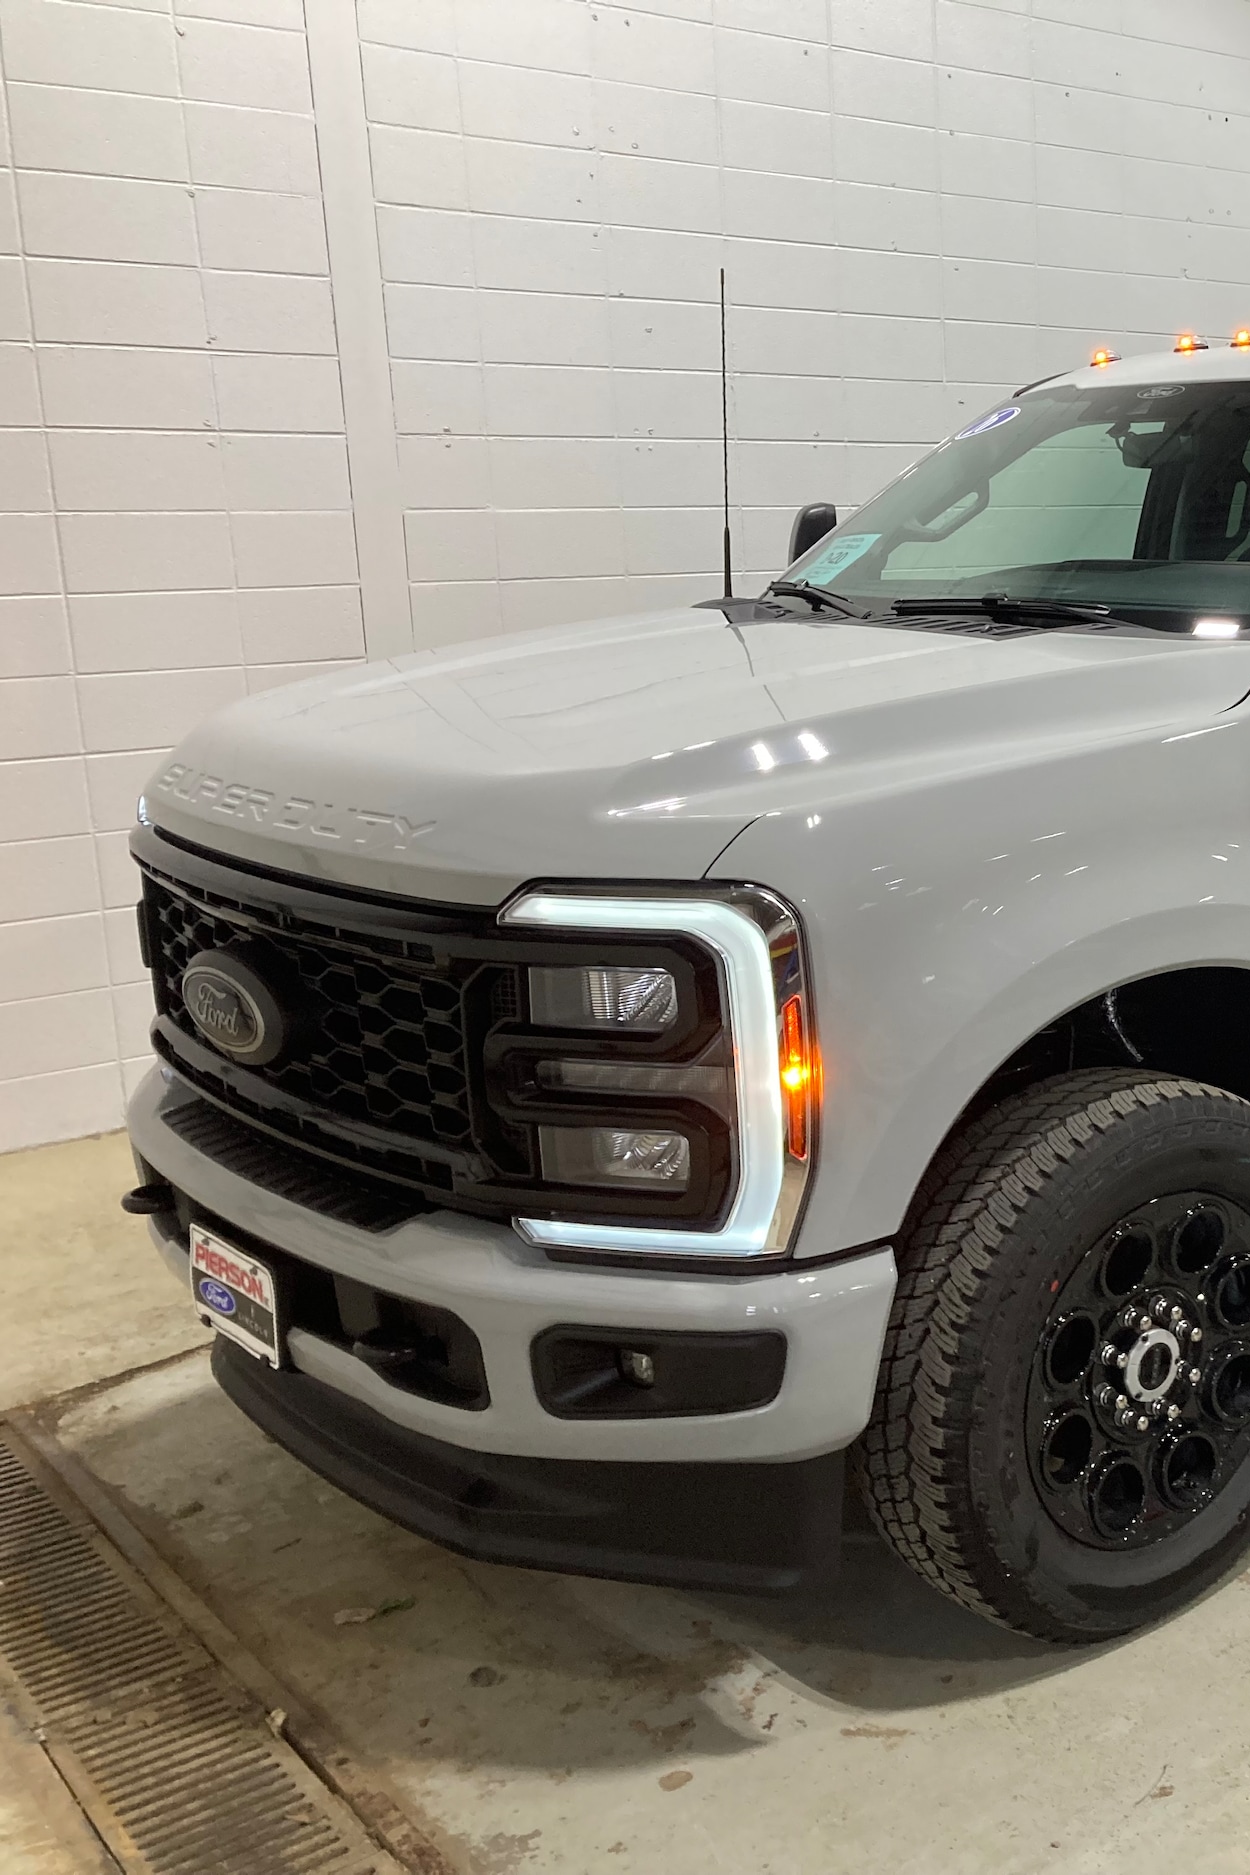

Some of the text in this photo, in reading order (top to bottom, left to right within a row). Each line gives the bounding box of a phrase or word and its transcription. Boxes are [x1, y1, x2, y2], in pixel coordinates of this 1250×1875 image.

[157, 763, 437, 849] SUPER DUTY
[198, 982, 240, 1037] Ford
[195, 1243, 265, 1303] PIERSON
[205, 1282, 229, 1309] Ford
